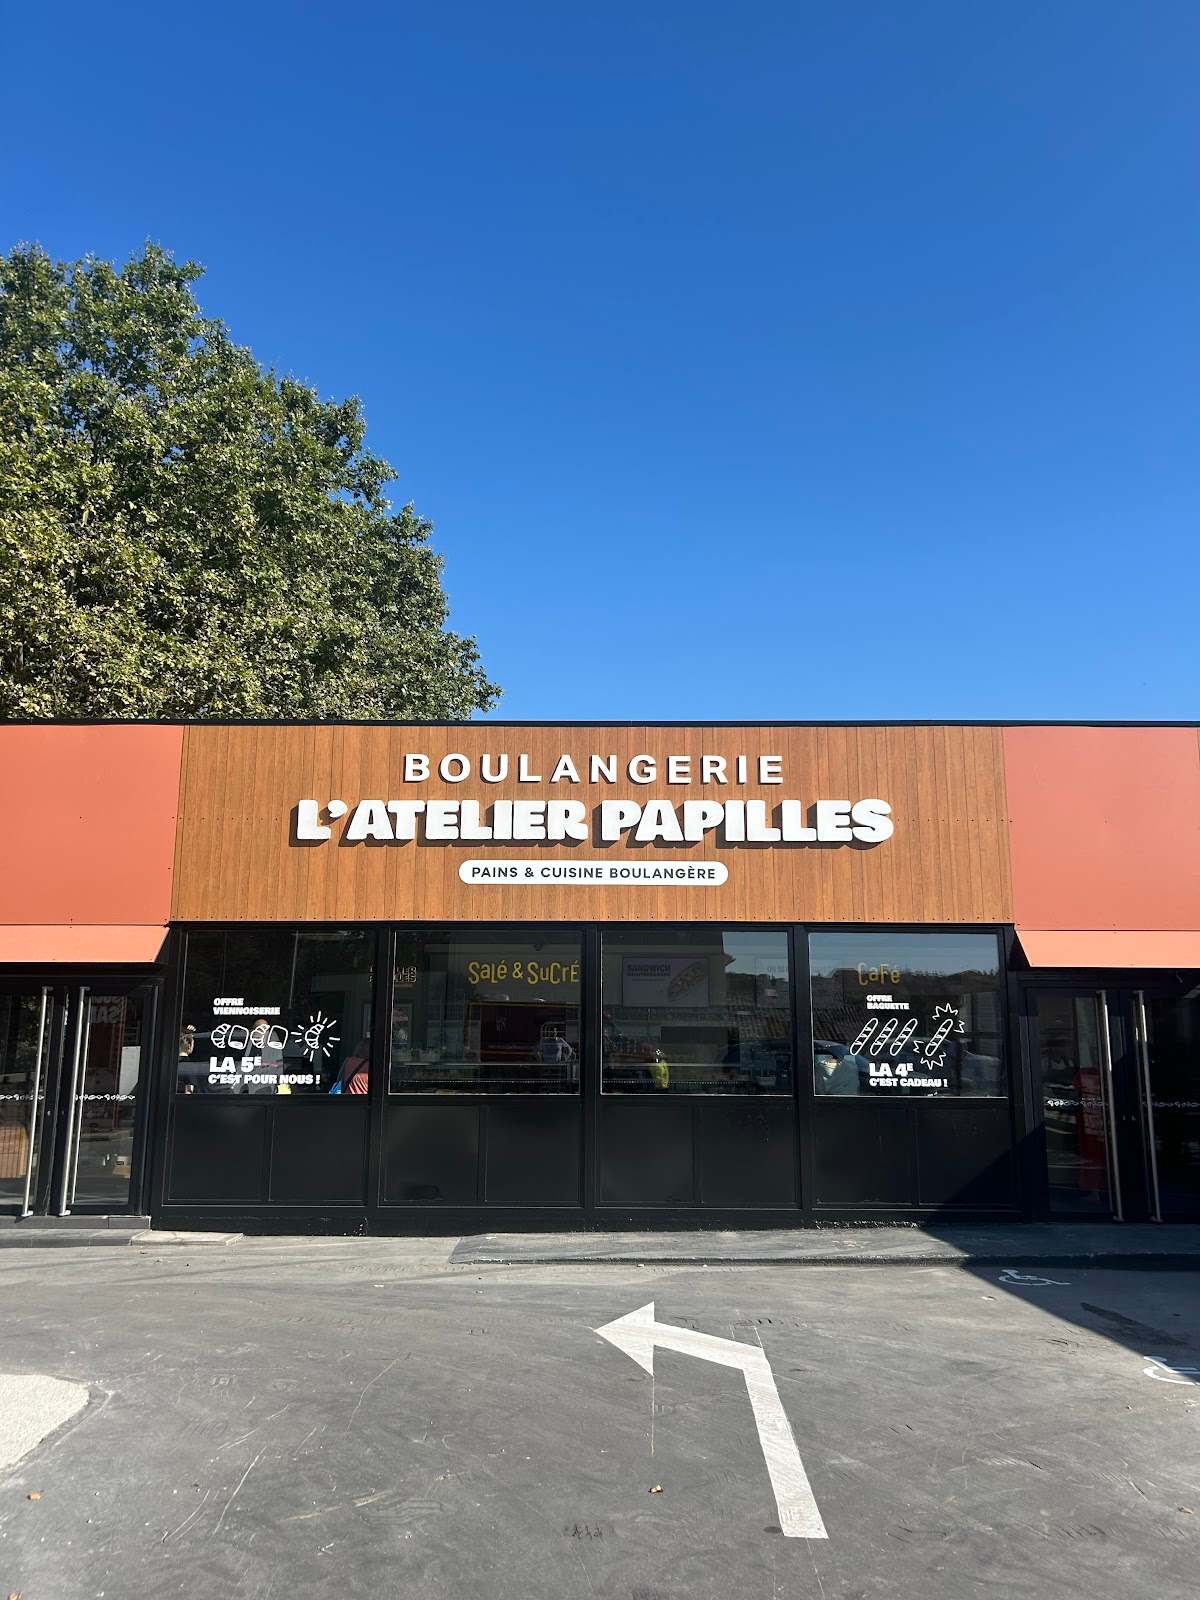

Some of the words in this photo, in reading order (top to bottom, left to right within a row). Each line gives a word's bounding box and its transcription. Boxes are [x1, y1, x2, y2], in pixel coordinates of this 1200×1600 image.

[404, 753, 784, 784] BOULANGERIE
[601, 799, 894, 842] PAPILLES
[471, 866, 518, 878] PAINS
[524, 867, 535, 878] &
[541, 867, 603, 878] CUISINE
[609, 865, 716, 879] BOULANGÈRE
[512, 961, 523, 979] &
[213, 997, 244, 1007] OFFRE
[866, 994, 893, 1003] OFFRE
[213, 1006, 280, 1016] VIENNOISERIE
[866, 1002, 910, 1010] BAGUETTE
[209, 1056, 236, 1073] LA
[869, 1062, 892, 1077] LA
[208, 1074, 241, 1085] C'EST
[244, 1074, 278, 1084] POUR
[279, 1074, 314, 1084] NOUS
[869, 1077, 898, 1087] C'EST
[899, 1078, 941, 1088] CADEAU
